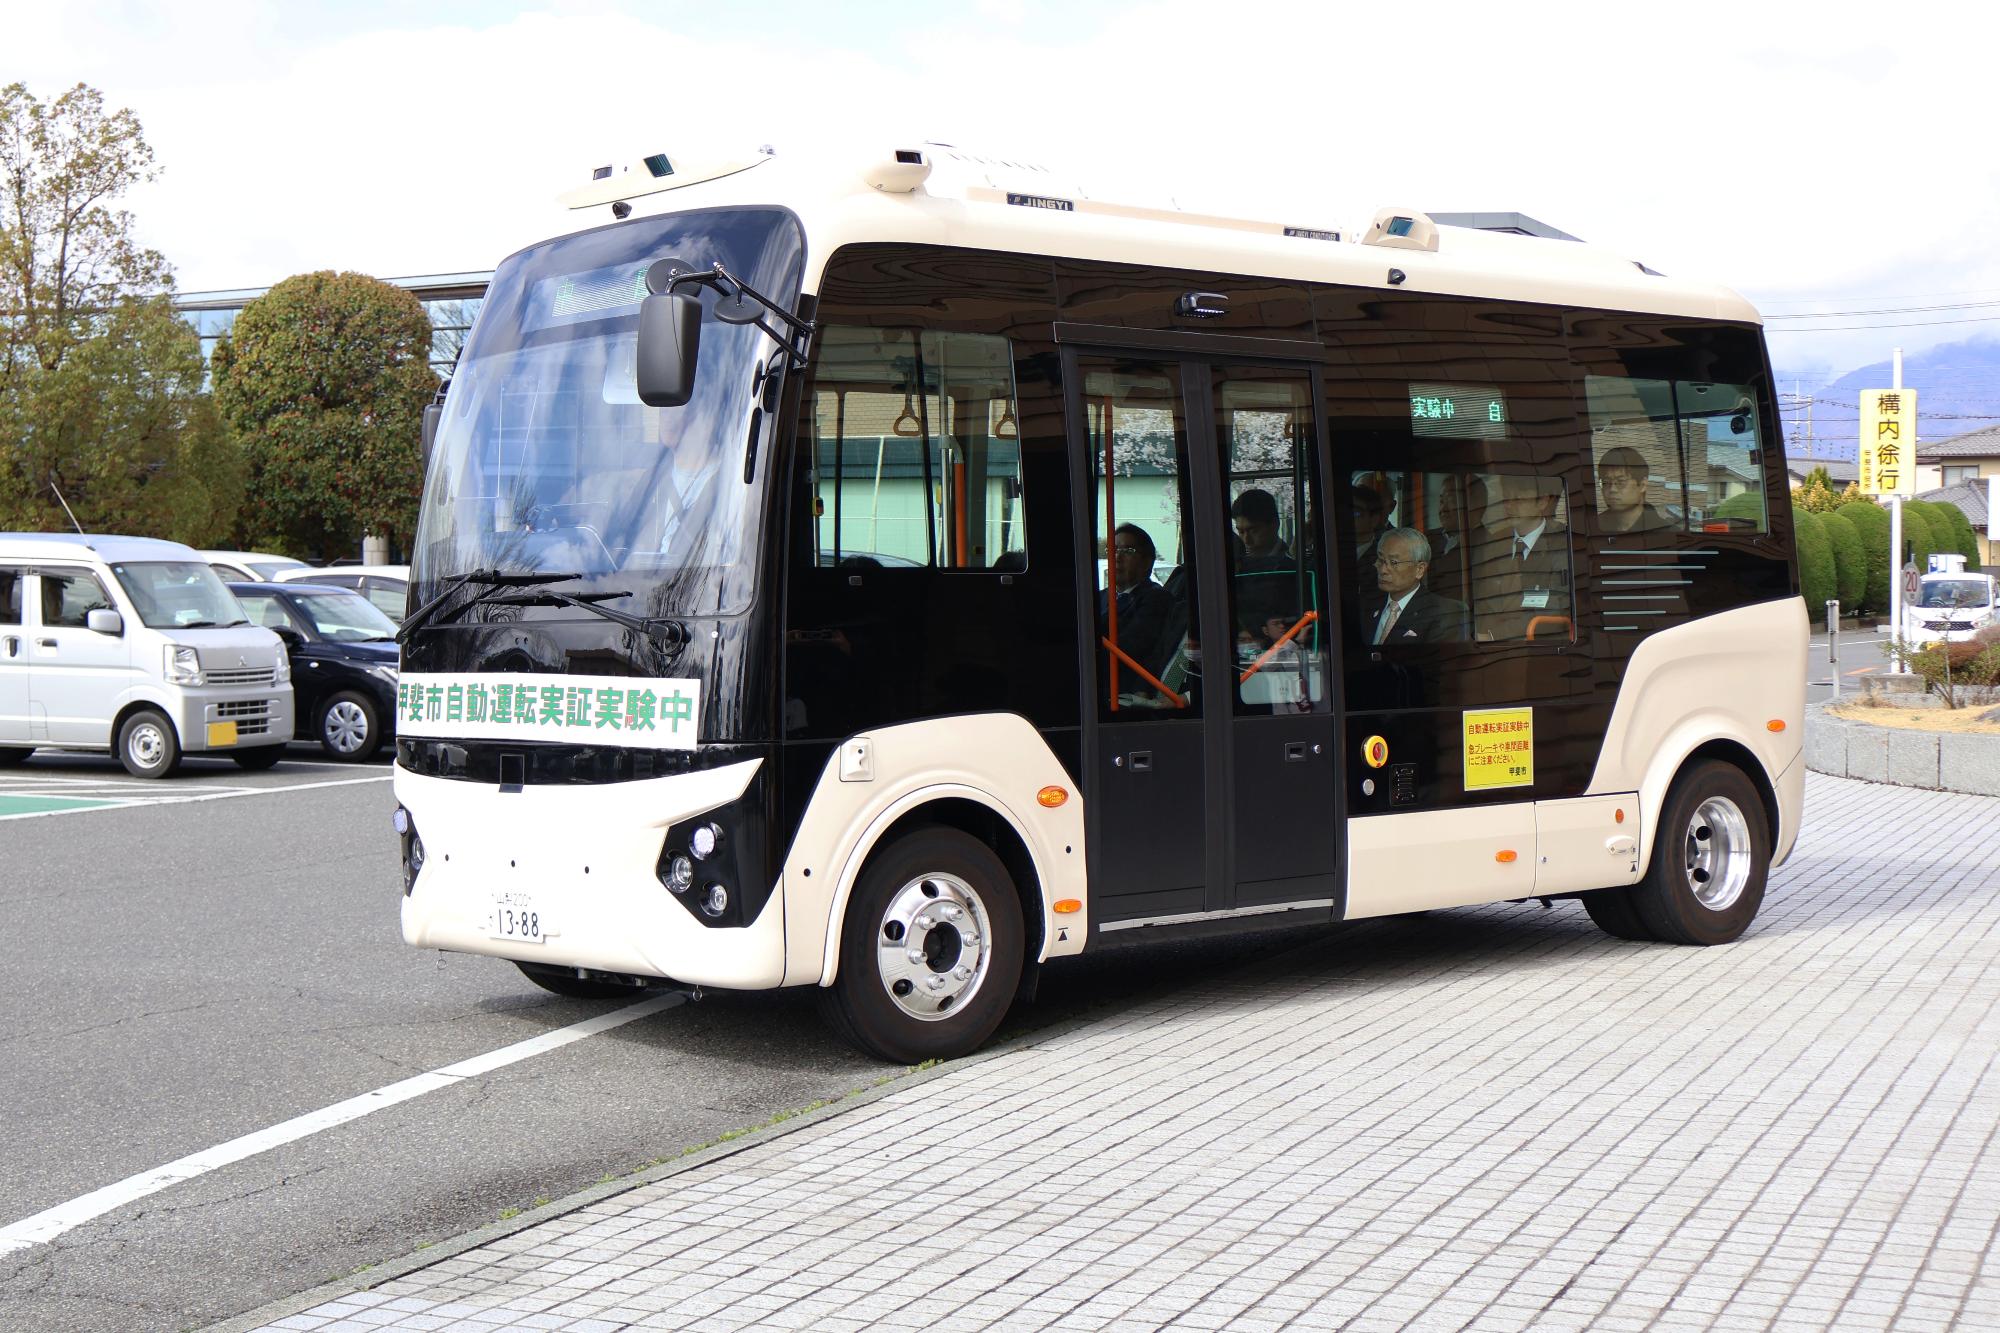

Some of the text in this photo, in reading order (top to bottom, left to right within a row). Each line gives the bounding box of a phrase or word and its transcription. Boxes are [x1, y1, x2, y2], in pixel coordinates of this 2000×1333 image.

[1024, 198, 1068, 211] JINGYI
[1412, 397, 1454, 418] 実験中
[1489, 401, 1505, 421] 自
[1877, 394, 1900, 490] 構内徐行
[1905, 571, 1917, 592] 20
[399, 683, 692, 733] 甲斐市自動運転実証実験中
[1468, 721, 1530, 735] 自動運転実証実験中
